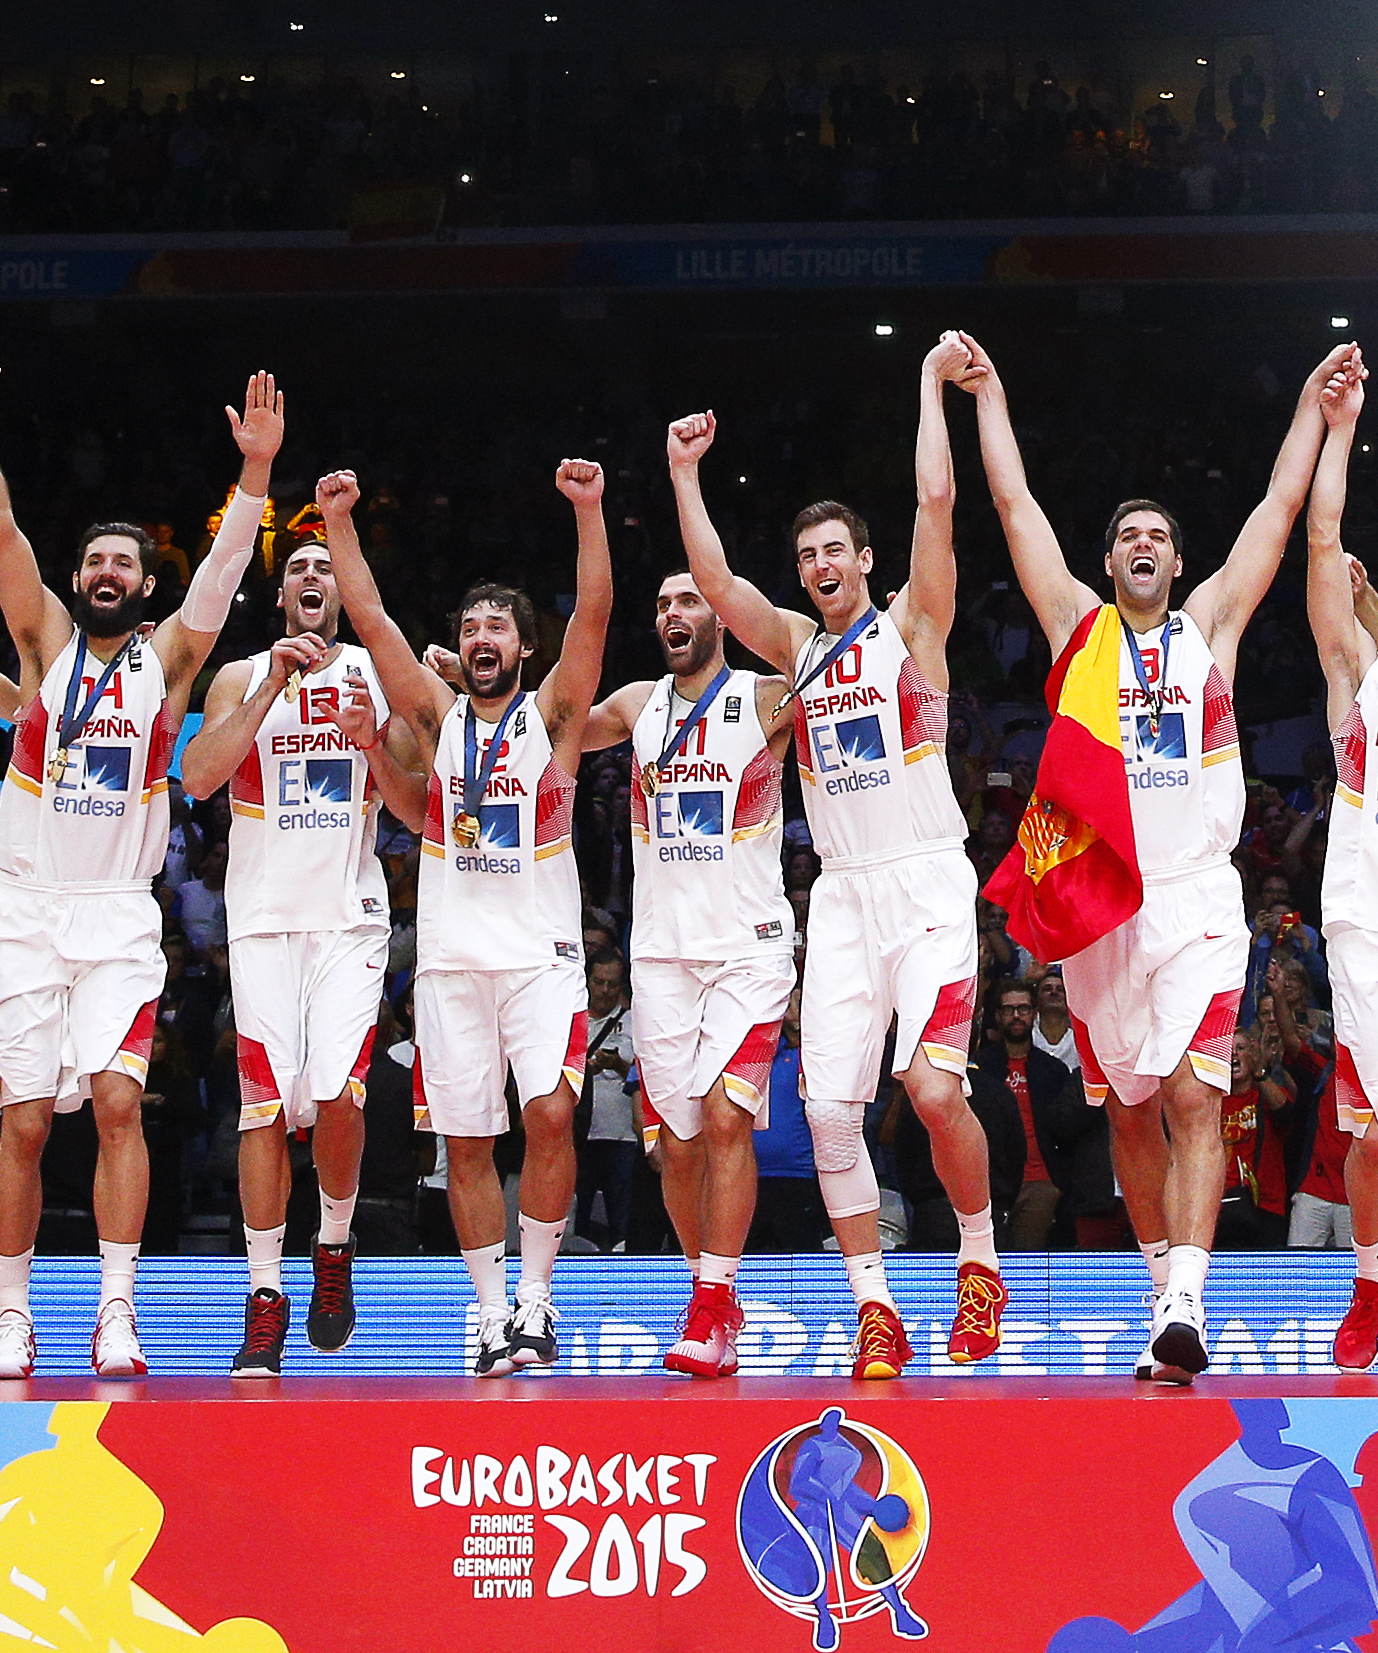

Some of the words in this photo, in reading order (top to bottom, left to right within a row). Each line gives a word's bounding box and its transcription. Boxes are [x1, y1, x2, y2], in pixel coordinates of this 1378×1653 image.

[675, 249, 748, 279] LILLE
[754, 242, 923, 278] MÉTROPOLE
[298, 686, 340, 726] 13
[805, 685, 887, 720] ESPAÑA
[271, 728, 362, 755] ESPAÑA
[675, 716, 708, 757] 11
[658, 759, 733, 784] SPAÑA
[825, 768, 891, 796] endesa
[1126, 766, 1189, 790] ndesa
[53, 795, 126, 817] endesa
[278, 808, 351, 831] endesa
[455, 853, 521, 874] endesa
[659, 841, 724, 863] endesa
[410, 1444, 719, 1511] EUROBASKET
[469, 1513, 535, 1534] FRANCE
[462, 1536, 535, 1556] CROATIA
[542, 1512, 709, 1599] 2015
[452, 1557, 535, 1578] GERMANY
[472, 1579, 534, 1600] LATVIA
